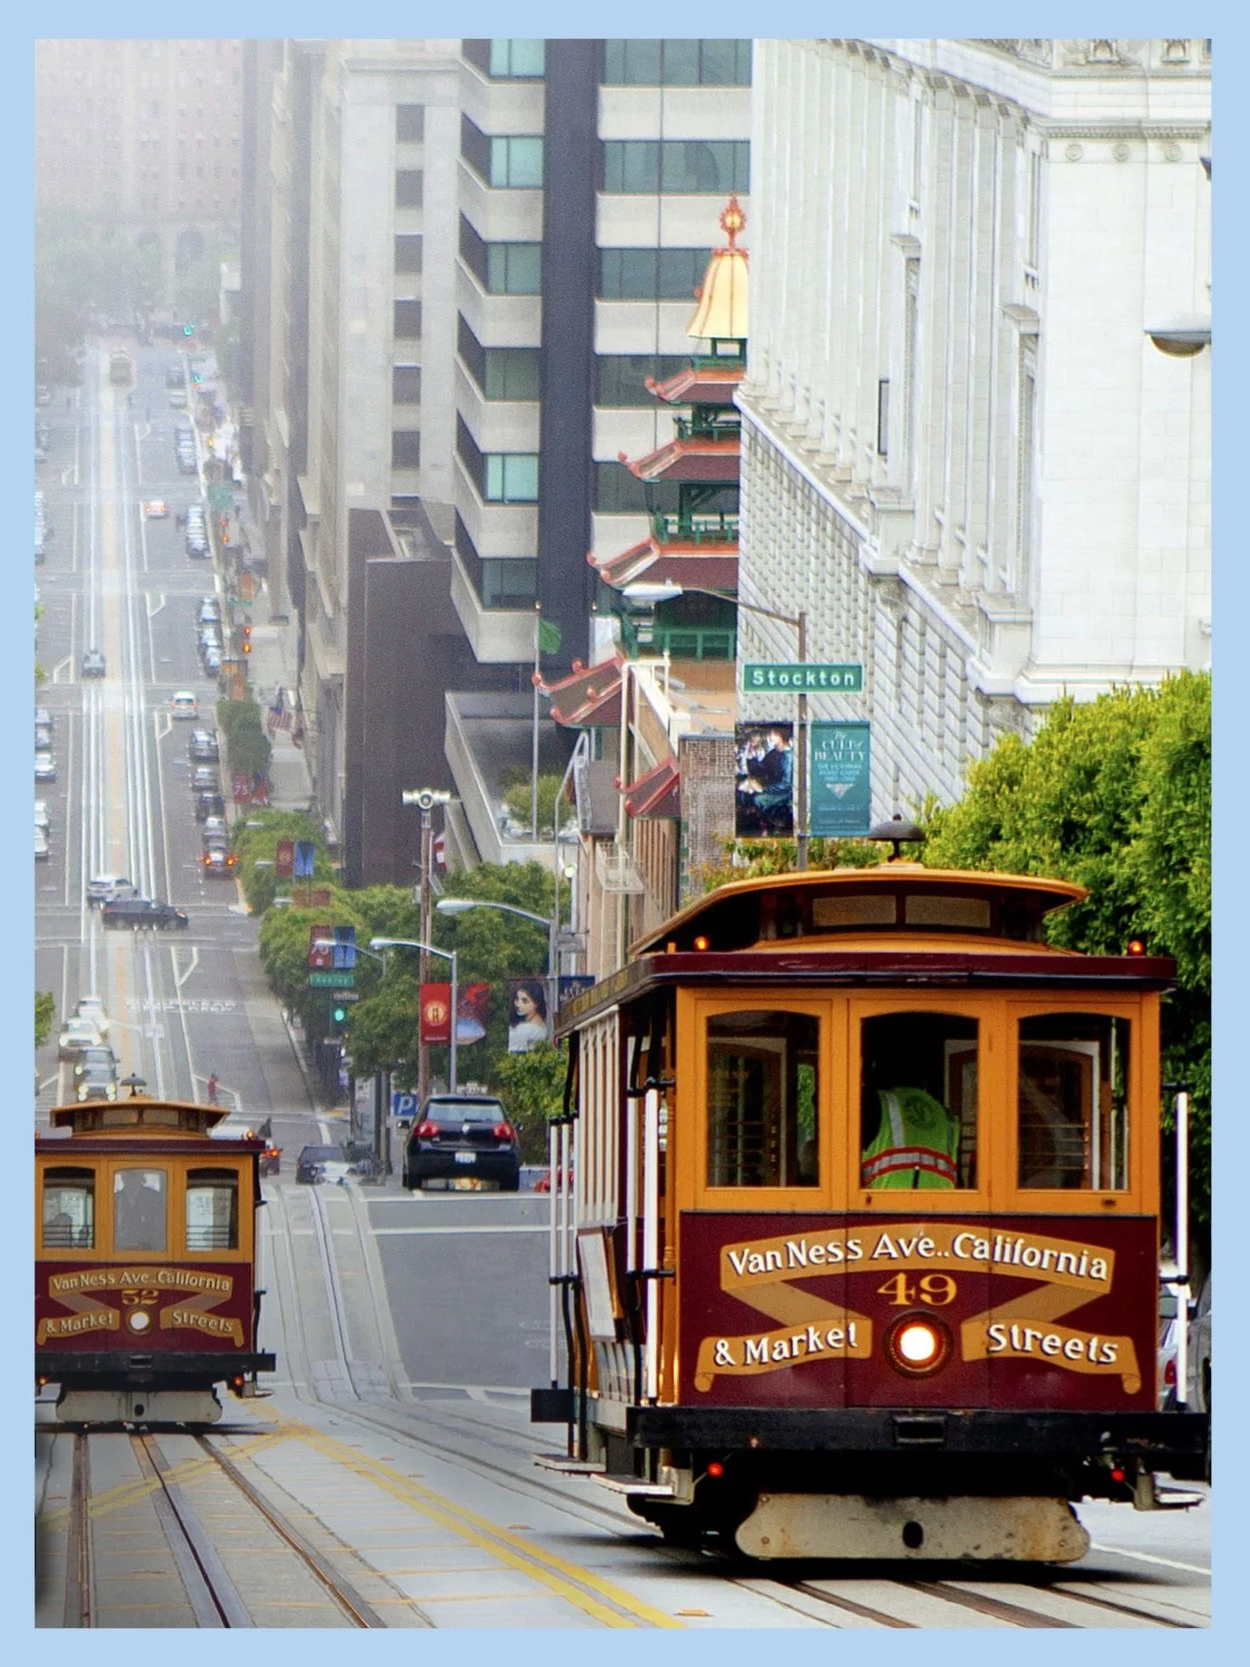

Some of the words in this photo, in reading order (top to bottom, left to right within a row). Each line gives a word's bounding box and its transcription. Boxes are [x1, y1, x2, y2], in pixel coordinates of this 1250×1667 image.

[752, 670, 855, 686] Stockton
[729, 1248, 783, 1276] Van
[785, 1239, 863, 1268] Ness
[953, 1232, 1108, 1280] California
[53, 1277, 78, 1291] Van
[80, 1272, 115, 1287] Ness
[157, 1270, 230, 1291] California
[877, 1272, 957, 1306] 49
[122, 1289, 159, 1305] 52
[46, 1320, 56, 1333] &
[60, 1313, 113, 1333] Market
[172, 1310, 233, 1332] Streets
[714, 1339, 736, 1366] &
[743, 1322, 858, 1365] Market
[987, 1323, 1118, 1364] Streets
